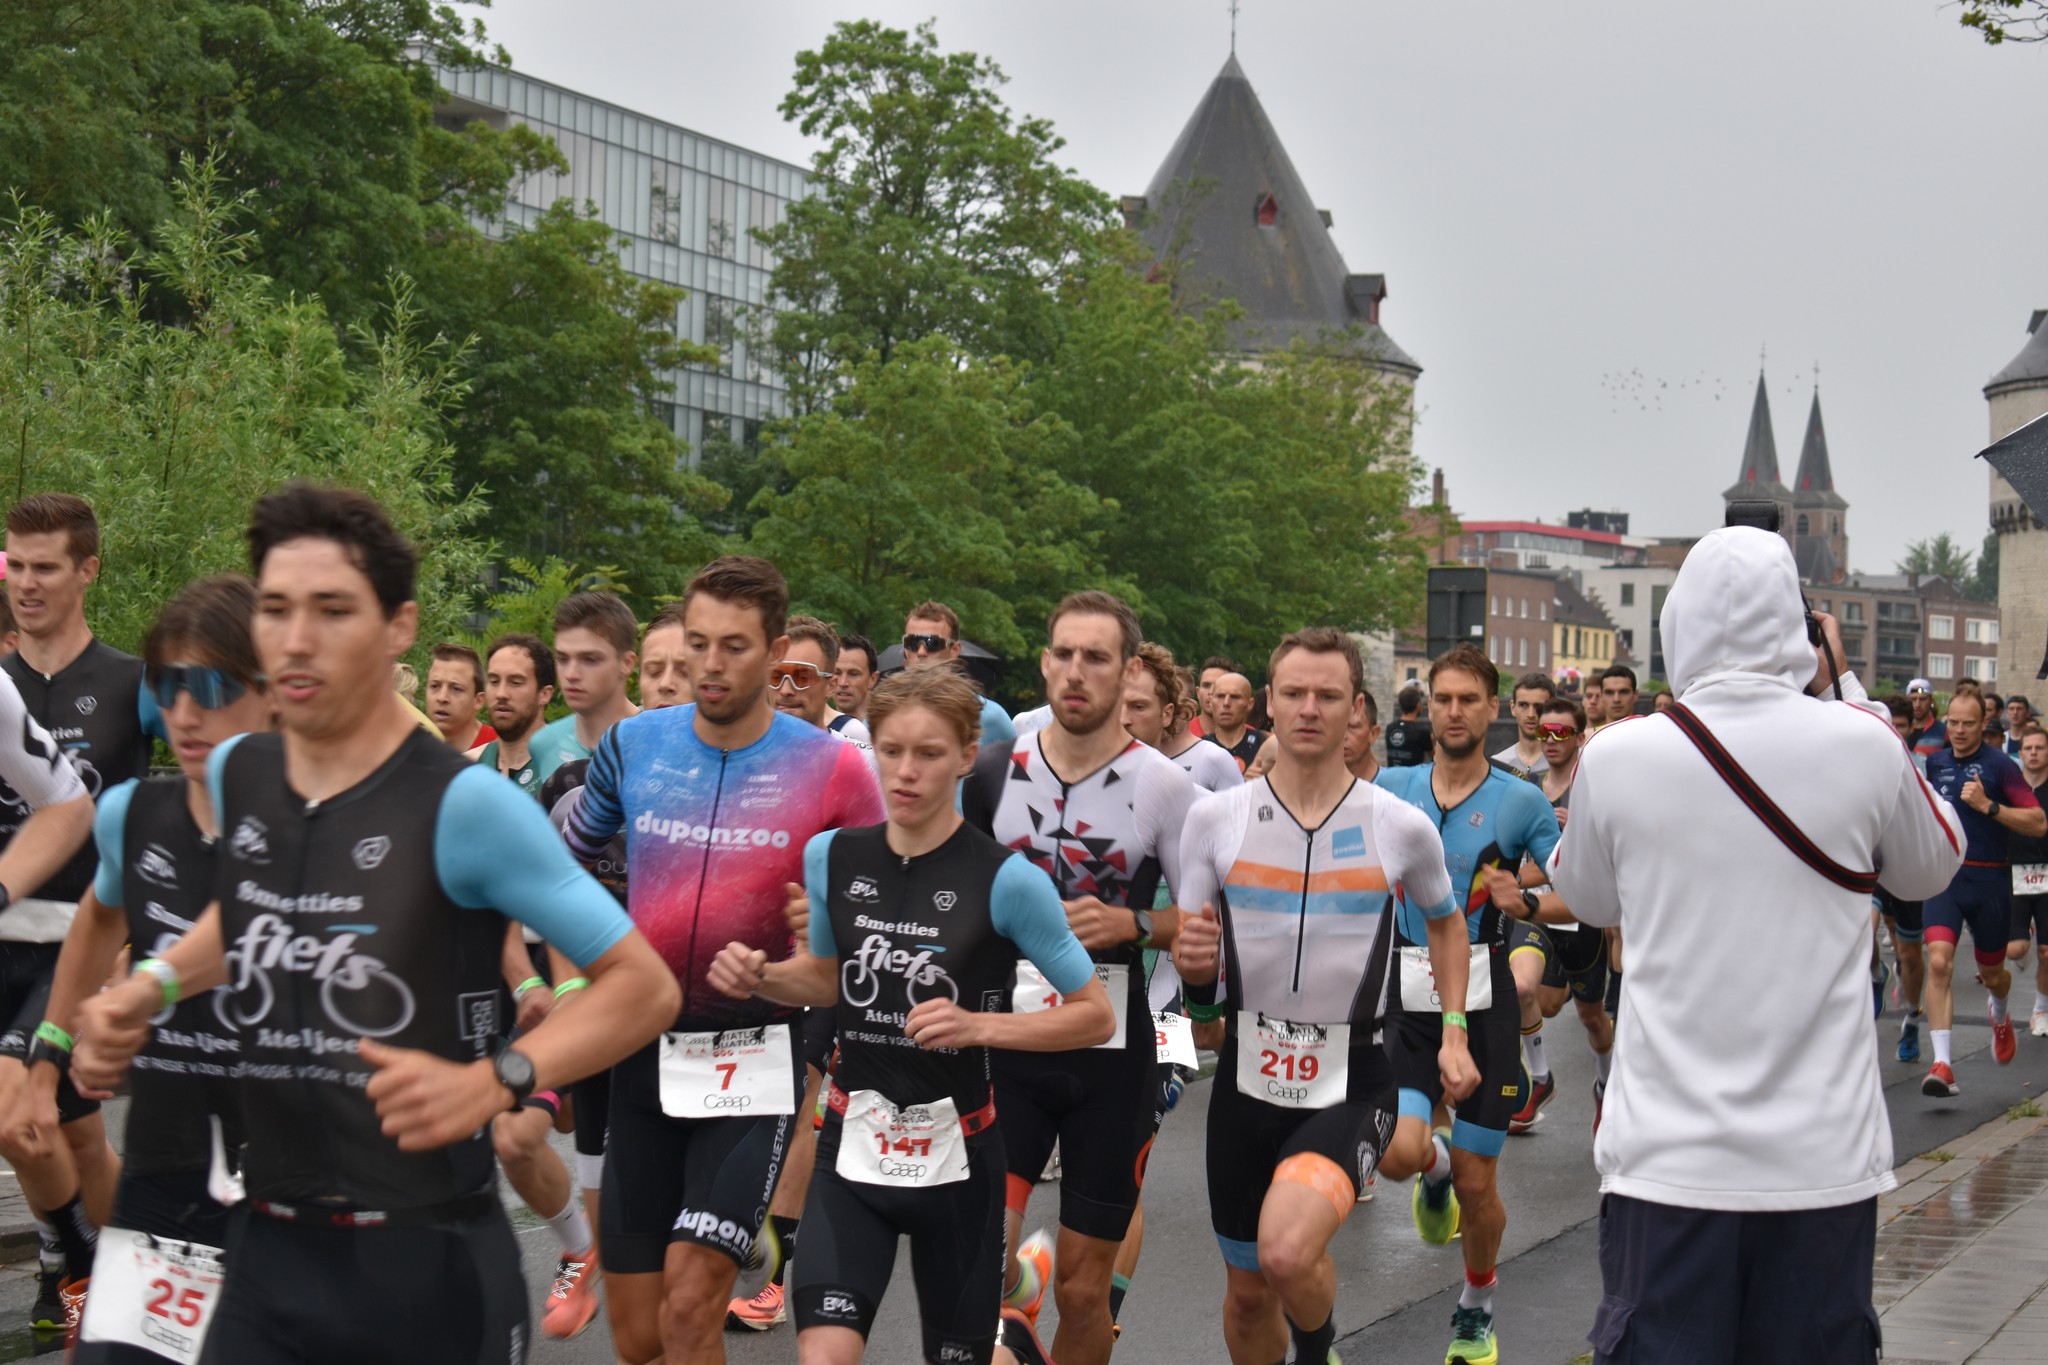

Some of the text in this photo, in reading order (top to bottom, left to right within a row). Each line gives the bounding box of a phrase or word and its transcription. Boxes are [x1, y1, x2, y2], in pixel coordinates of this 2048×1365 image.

[635, 809, 790, 848] duponzoo
[236, 880, 363, 914] Smetties
[850, 881, 878, 897] BMA
[854, 914, 939, 938] Smetties
[234, 913, 386, 992] fiets
[853, 933, 947, 987] fiets
[864, 1008, 908, 1028] Atelj
[859, 1032, 888, 1044] PASSIE
[888, 1036, 916, 1048] VOOR
[189, 1061, 226, 1077] VOOR
[715, 1062, 738, 1091] 7
[1260, 1049, 1319, 1082] 219
[874, 1132, 932, 1157] 147
[762, 1164, 777, 1203] IMMO
[144, 1277, 206, 1328] 25
[823, 1296, 857, 1313] BMA
